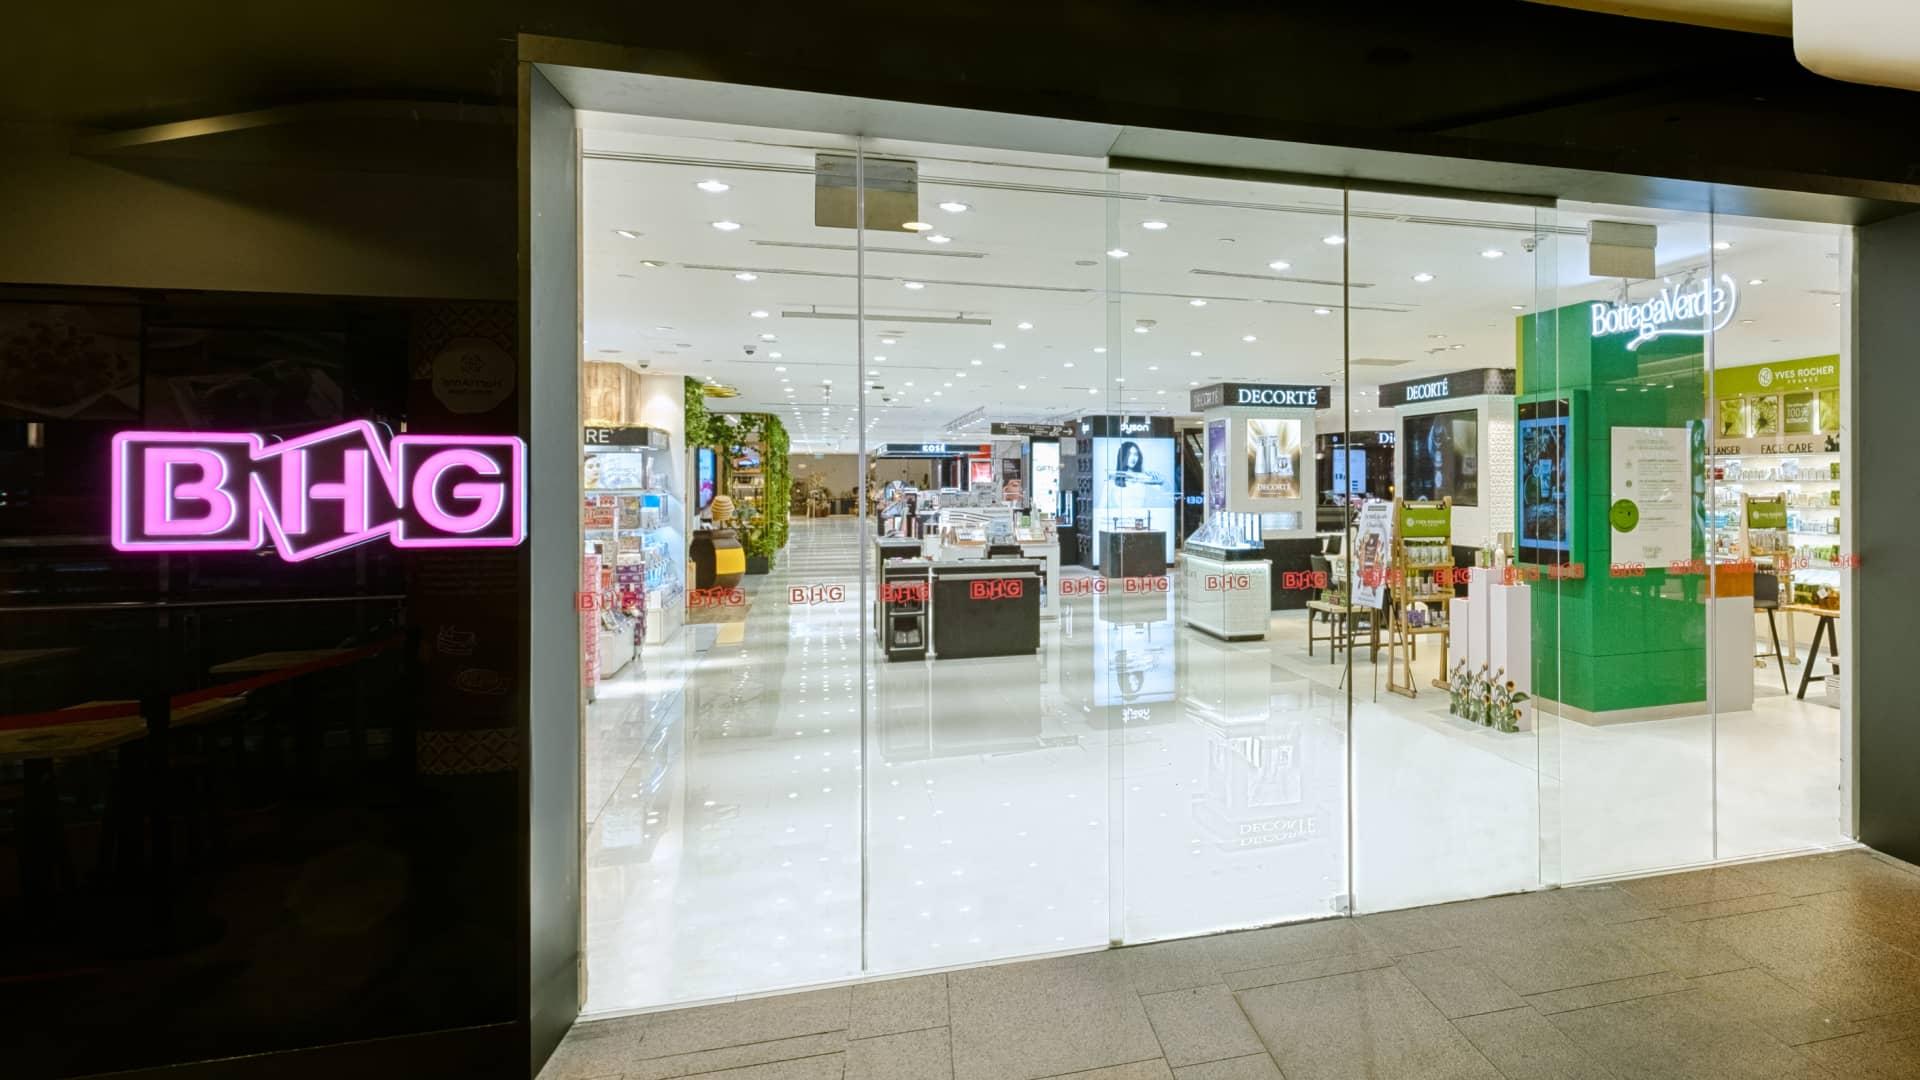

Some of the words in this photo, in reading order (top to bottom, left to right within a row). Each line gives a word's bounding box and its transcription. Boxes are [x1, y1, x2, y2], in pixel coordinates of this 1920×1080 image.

[1775, 370, 1795, 379] YVES
[1798, 366, 1834, 377] ROCHER
[1238, 388, 1318, 405] DECORTÉ
[1406, 377, 1449, 401] DECORTÉ
[1120, 422, 1150, 434] dyson
[1379, 432, 1395, 444] Di
[1788, 443, 1814, 453] CARE
[143, 447, 506, 536] BHG
[1062, 579, 1107, 596] BHG
[1126, 577, 1169, 593] BHG
[1207, 575, 1249, 591] BHG
[1285, 572, 1325, 588] BHG
[792, 587, 843, 604] BHG
[973, 580, 1021, 597] BHG
